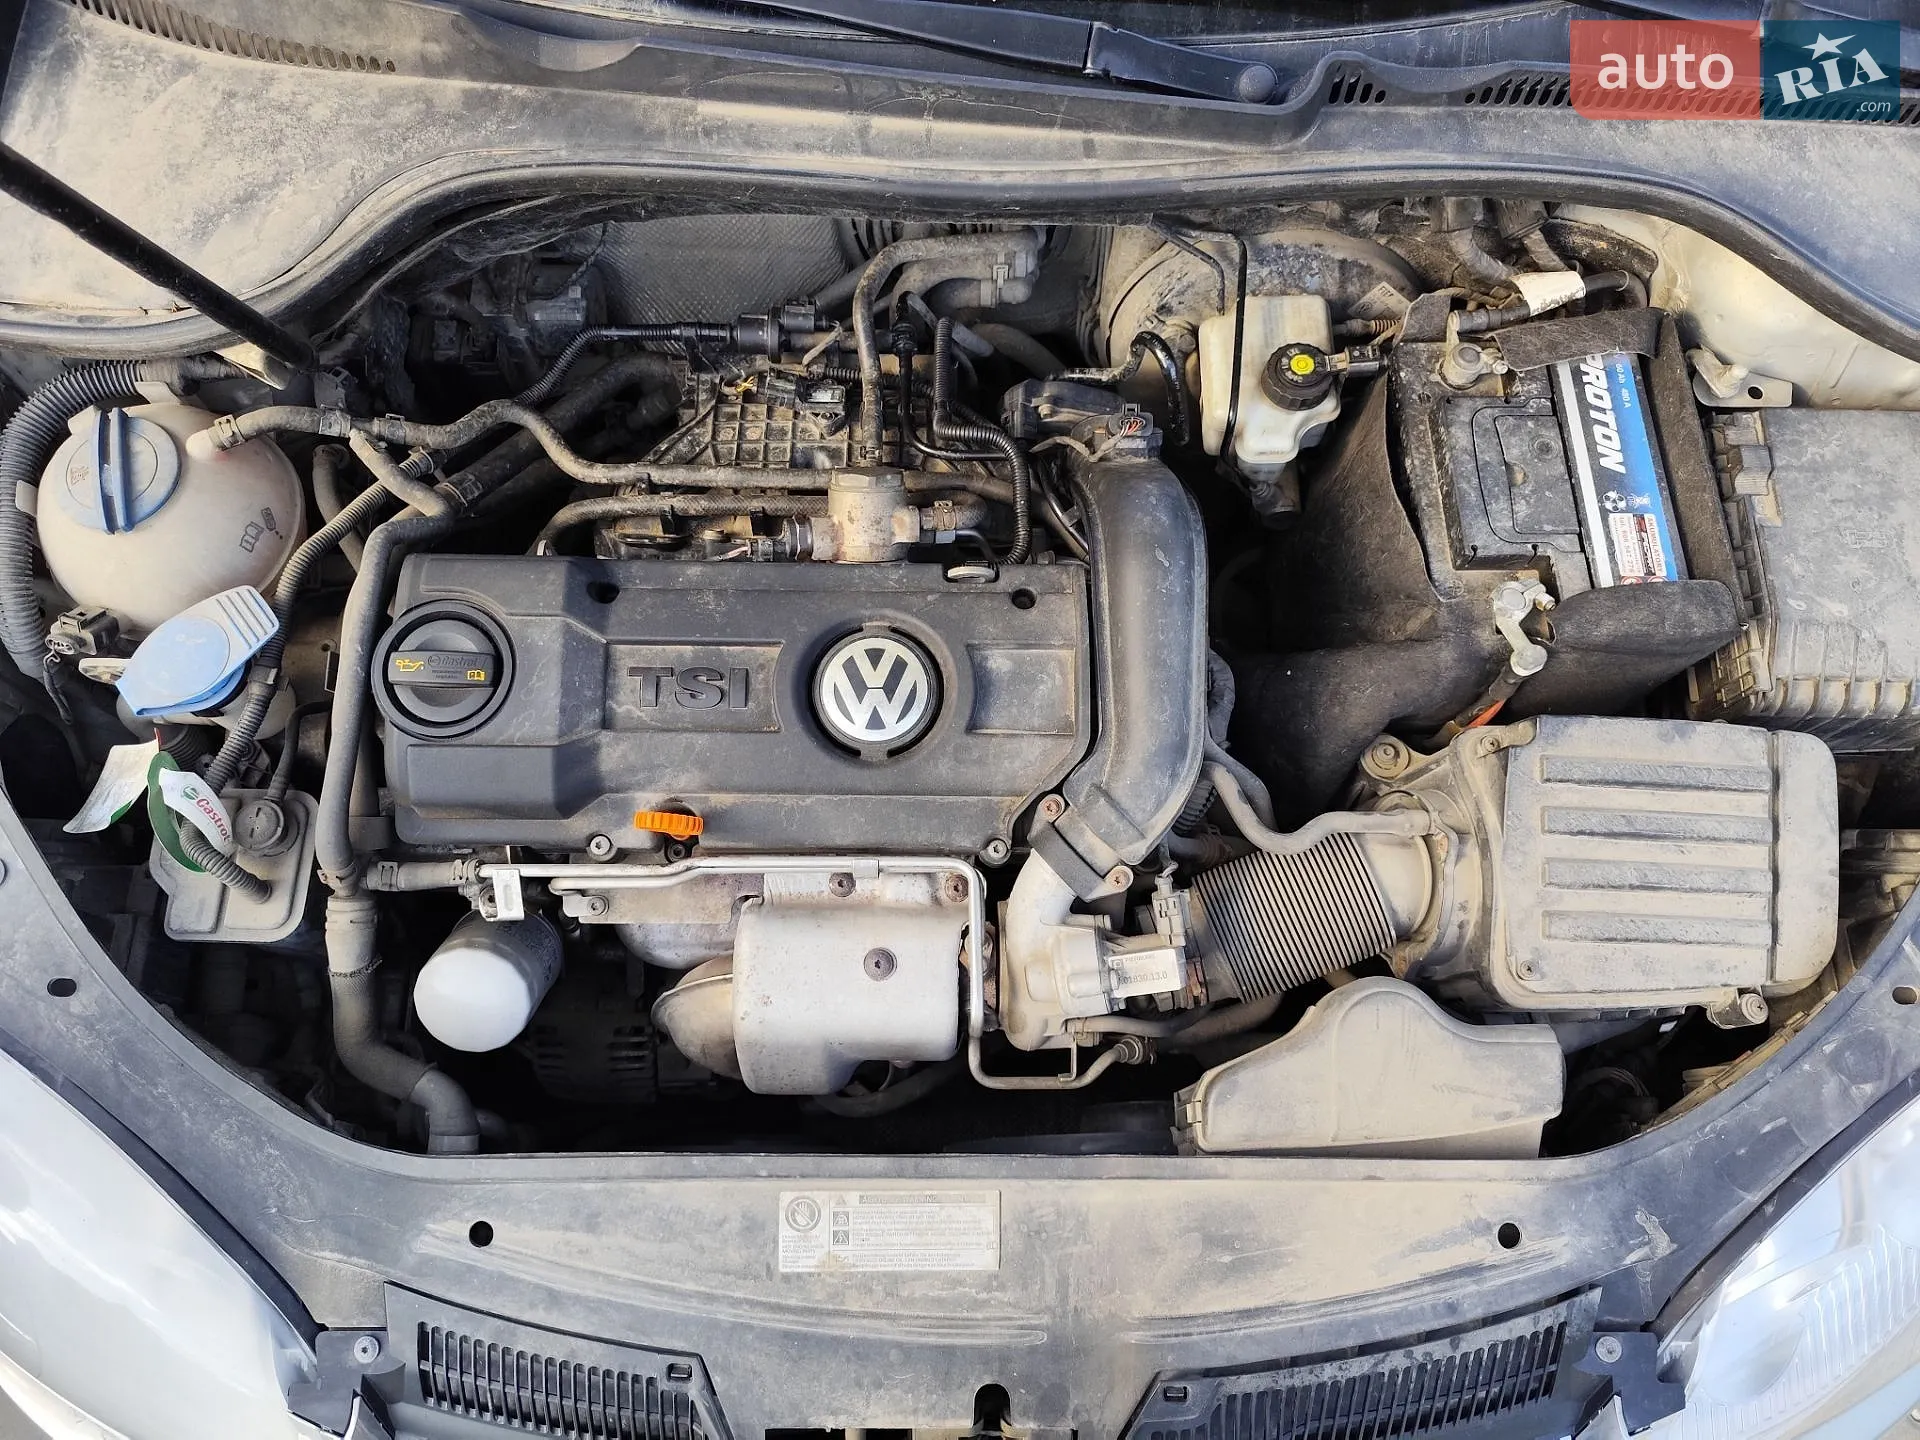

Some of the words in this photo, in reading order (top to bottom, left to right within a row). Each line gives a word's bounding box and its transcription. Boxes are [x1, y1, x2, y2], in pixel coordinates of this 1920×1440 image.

[1580, 353, 1627, 474] PROTON
[627, 665, 750, 710] TSI
[196, 798, 231, 842] Castrol
